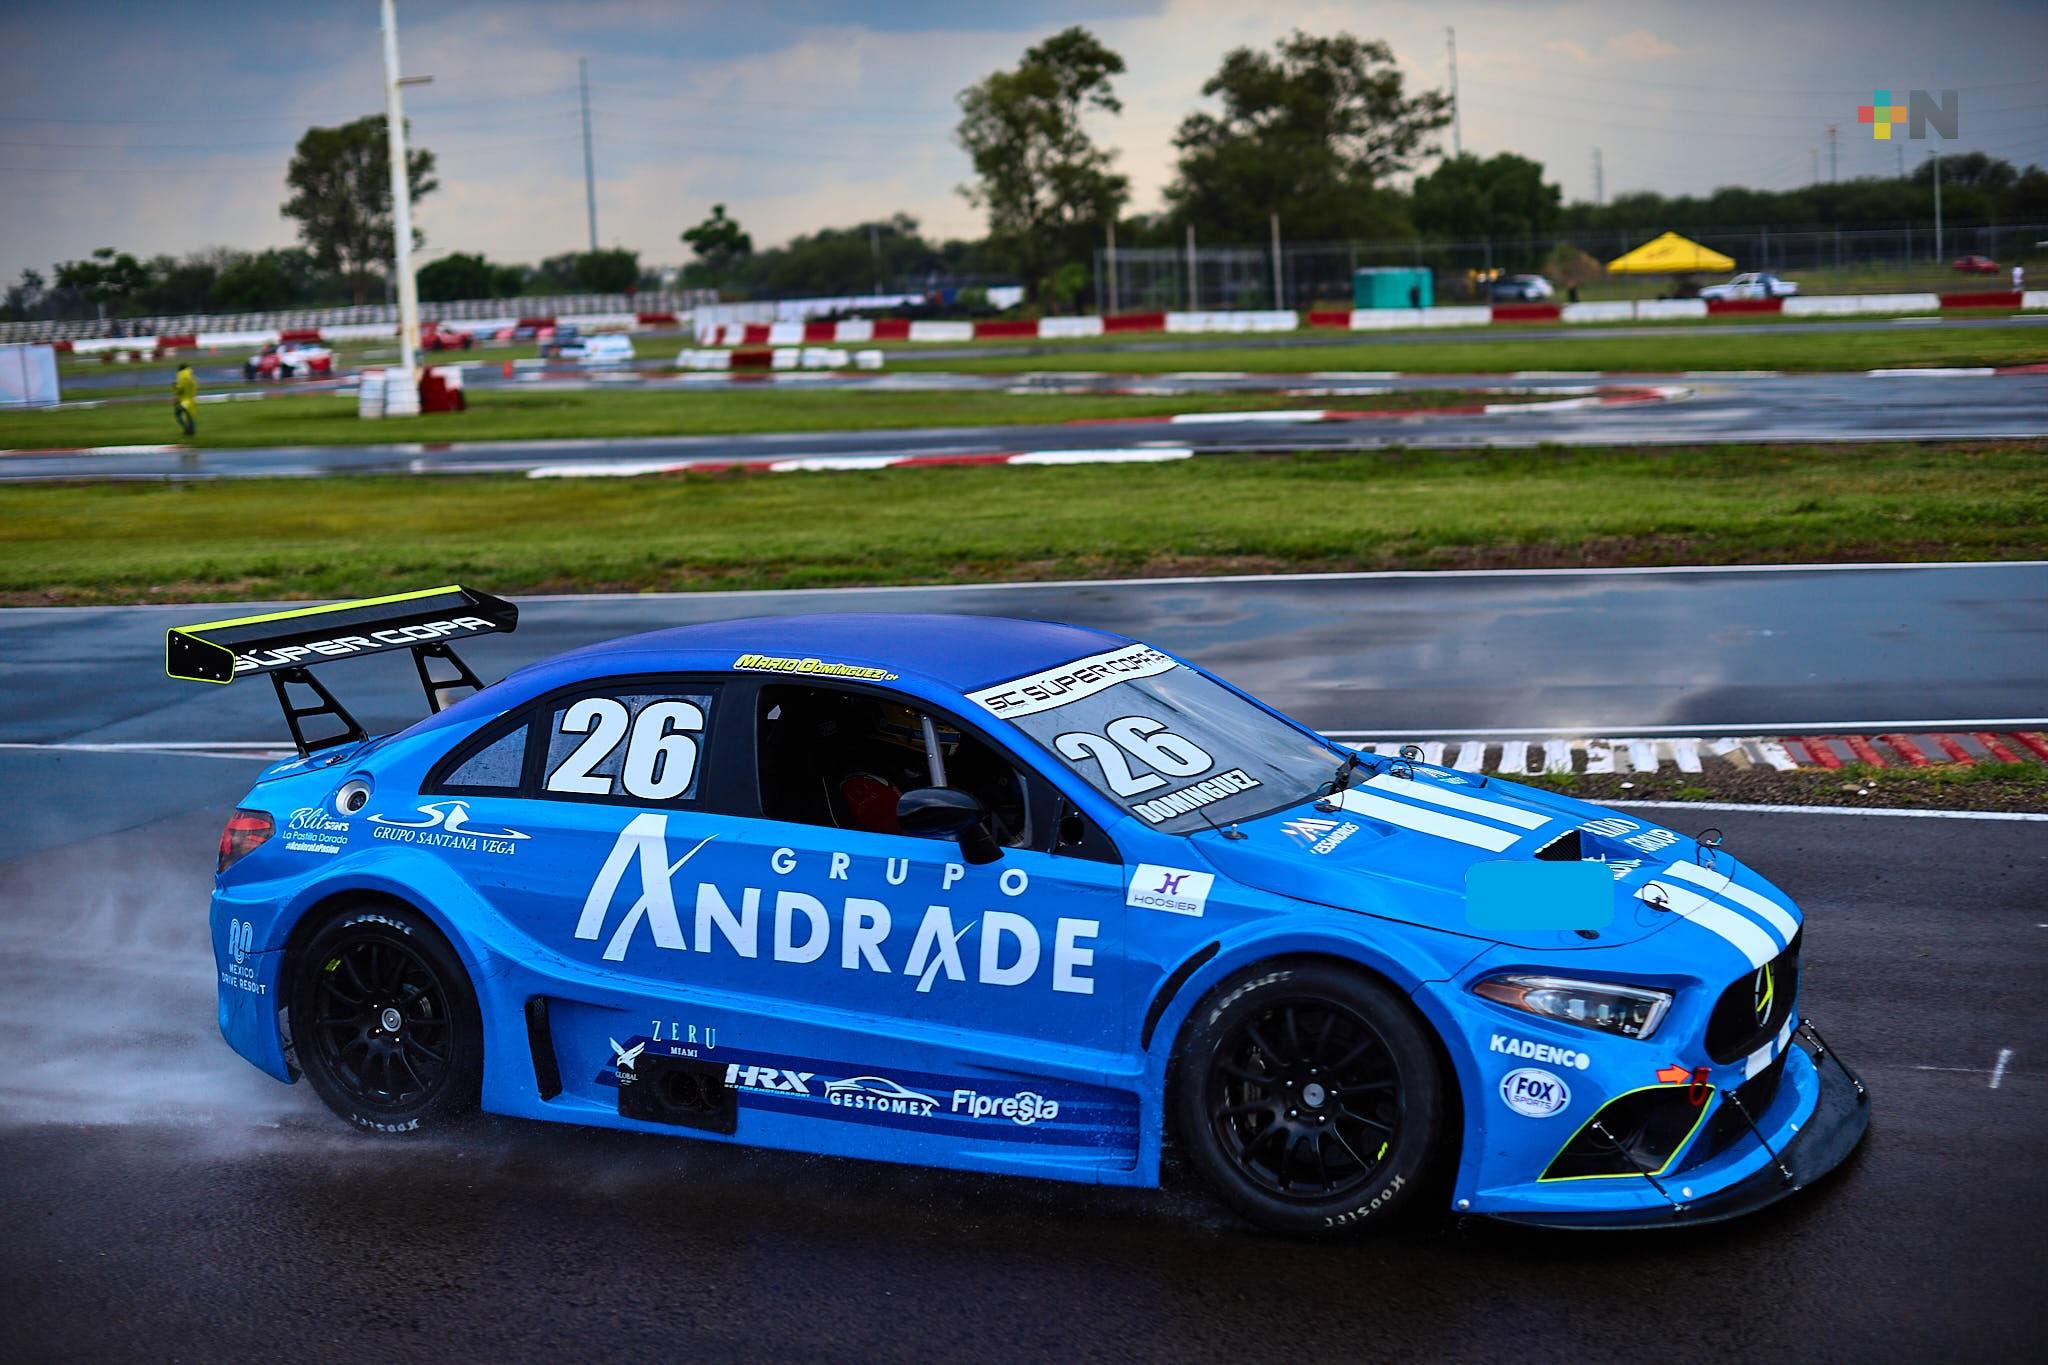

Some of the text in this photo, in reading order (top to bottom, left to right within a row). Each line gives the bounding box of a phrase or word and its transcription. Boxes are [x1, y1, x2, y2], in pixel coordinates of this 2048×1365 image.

[371, 616, 496, 648] COPA
[735, 655, 800, 671] MARIO
[984, 691, 1026, 711] SC
[1106, 653, 1156, 673] COPA
[546, 698, 704, 799] 26
[1055, 716, 1214, 797] 26
[1131, 769, 1262, 824] DOMINGUEZ
[282, 830, 292, 839] La
[318, 834, 348, 844] Dorada
[373, 826, 516, 855] GRUPO SANTANA VEGA
[770, 847, 1029, 896] GRUPO
[574, 813, 1100, 994] ANDRADE
[1133, 894, 1197, 912] HOOSIER
[221, 971, 238, 987] DRIVE
[229, 963, 254, 979] MEXICO
[651, 1020, 716, 1050] ZERU
[670, 1046, 698, 1058] MIAMI
[615, 1070, 639, 1081] GLOBAL
[724, 1063, 816, 1093] HRX
[1516, 1077, 1555, 1101] FOX
[829, 1092, 933, 1117] GESTOMEX
[1513, 1095, 1553, 1109] SPORTS
